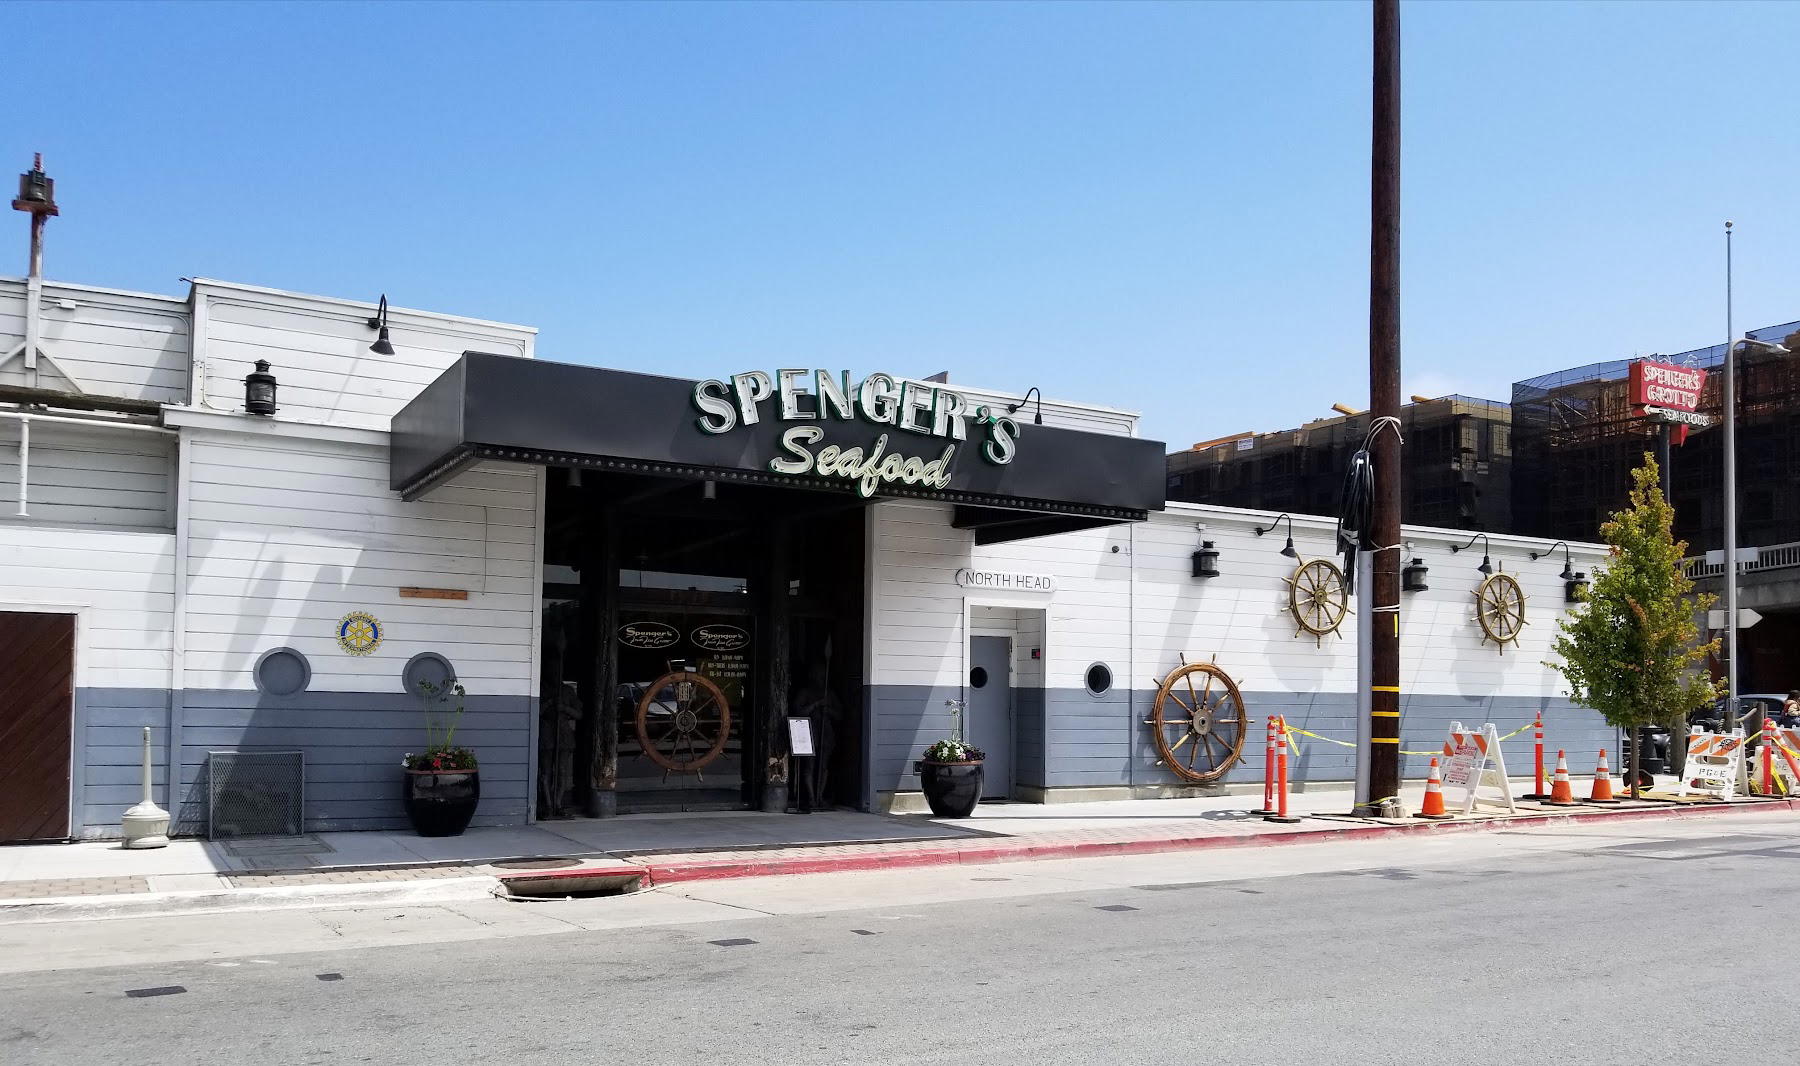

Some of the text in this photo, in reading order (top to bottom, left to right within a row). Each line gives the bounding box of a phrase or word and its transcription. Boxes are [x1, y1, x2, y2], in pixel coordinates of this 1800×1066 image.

[692, 368, 1020, 465] SPENGER'S
[768, 425, 956, 498] Seafood
[965, 572, 1051, 590] NORTH HEAD
